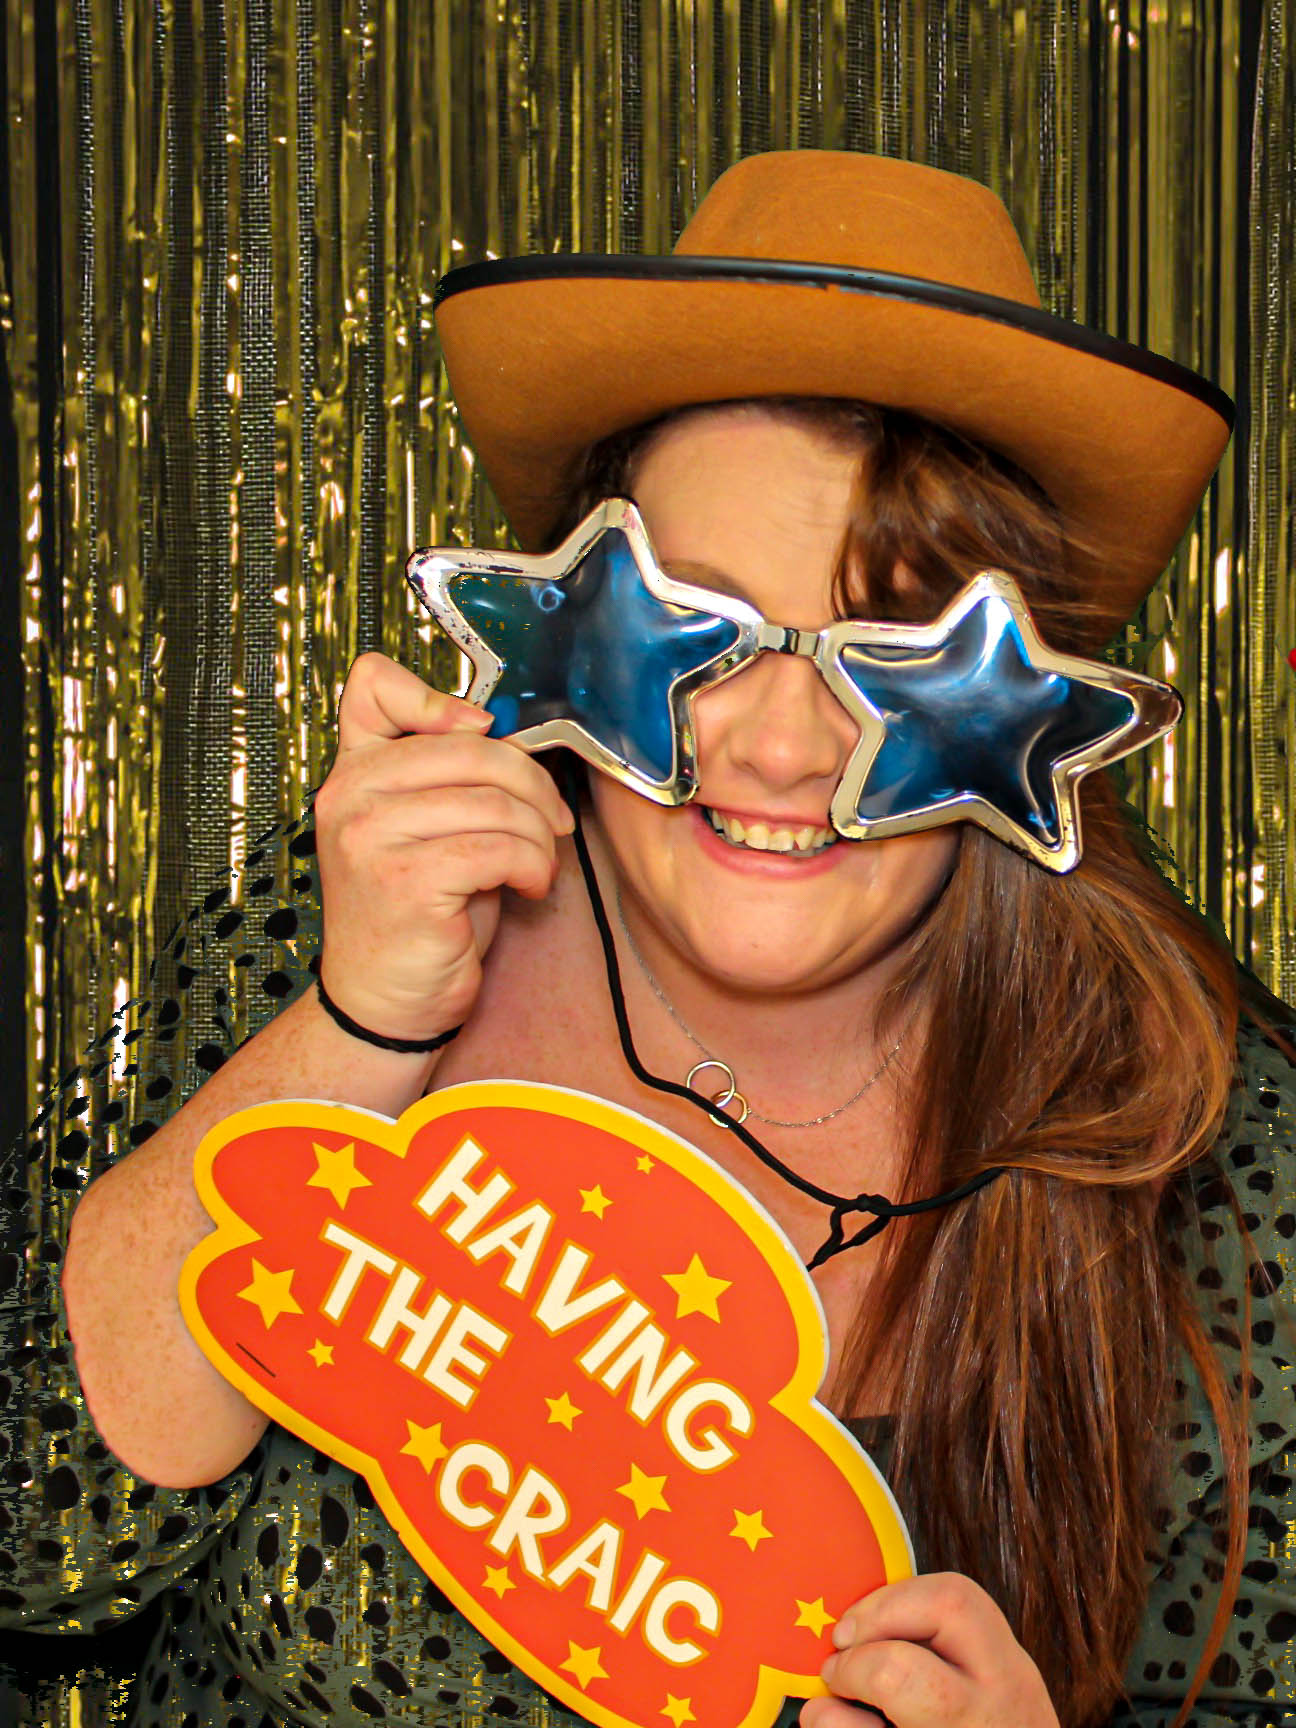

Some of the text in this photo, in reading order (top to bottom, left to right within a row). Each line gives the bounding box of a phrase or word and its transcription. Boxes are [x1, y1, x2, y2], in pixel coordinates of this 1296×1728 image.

[321, 1221, 510, 1408] THE
[417, 1137, 752, 1471] HAVING
[438, 1441, 720, 1665] CRAIC
